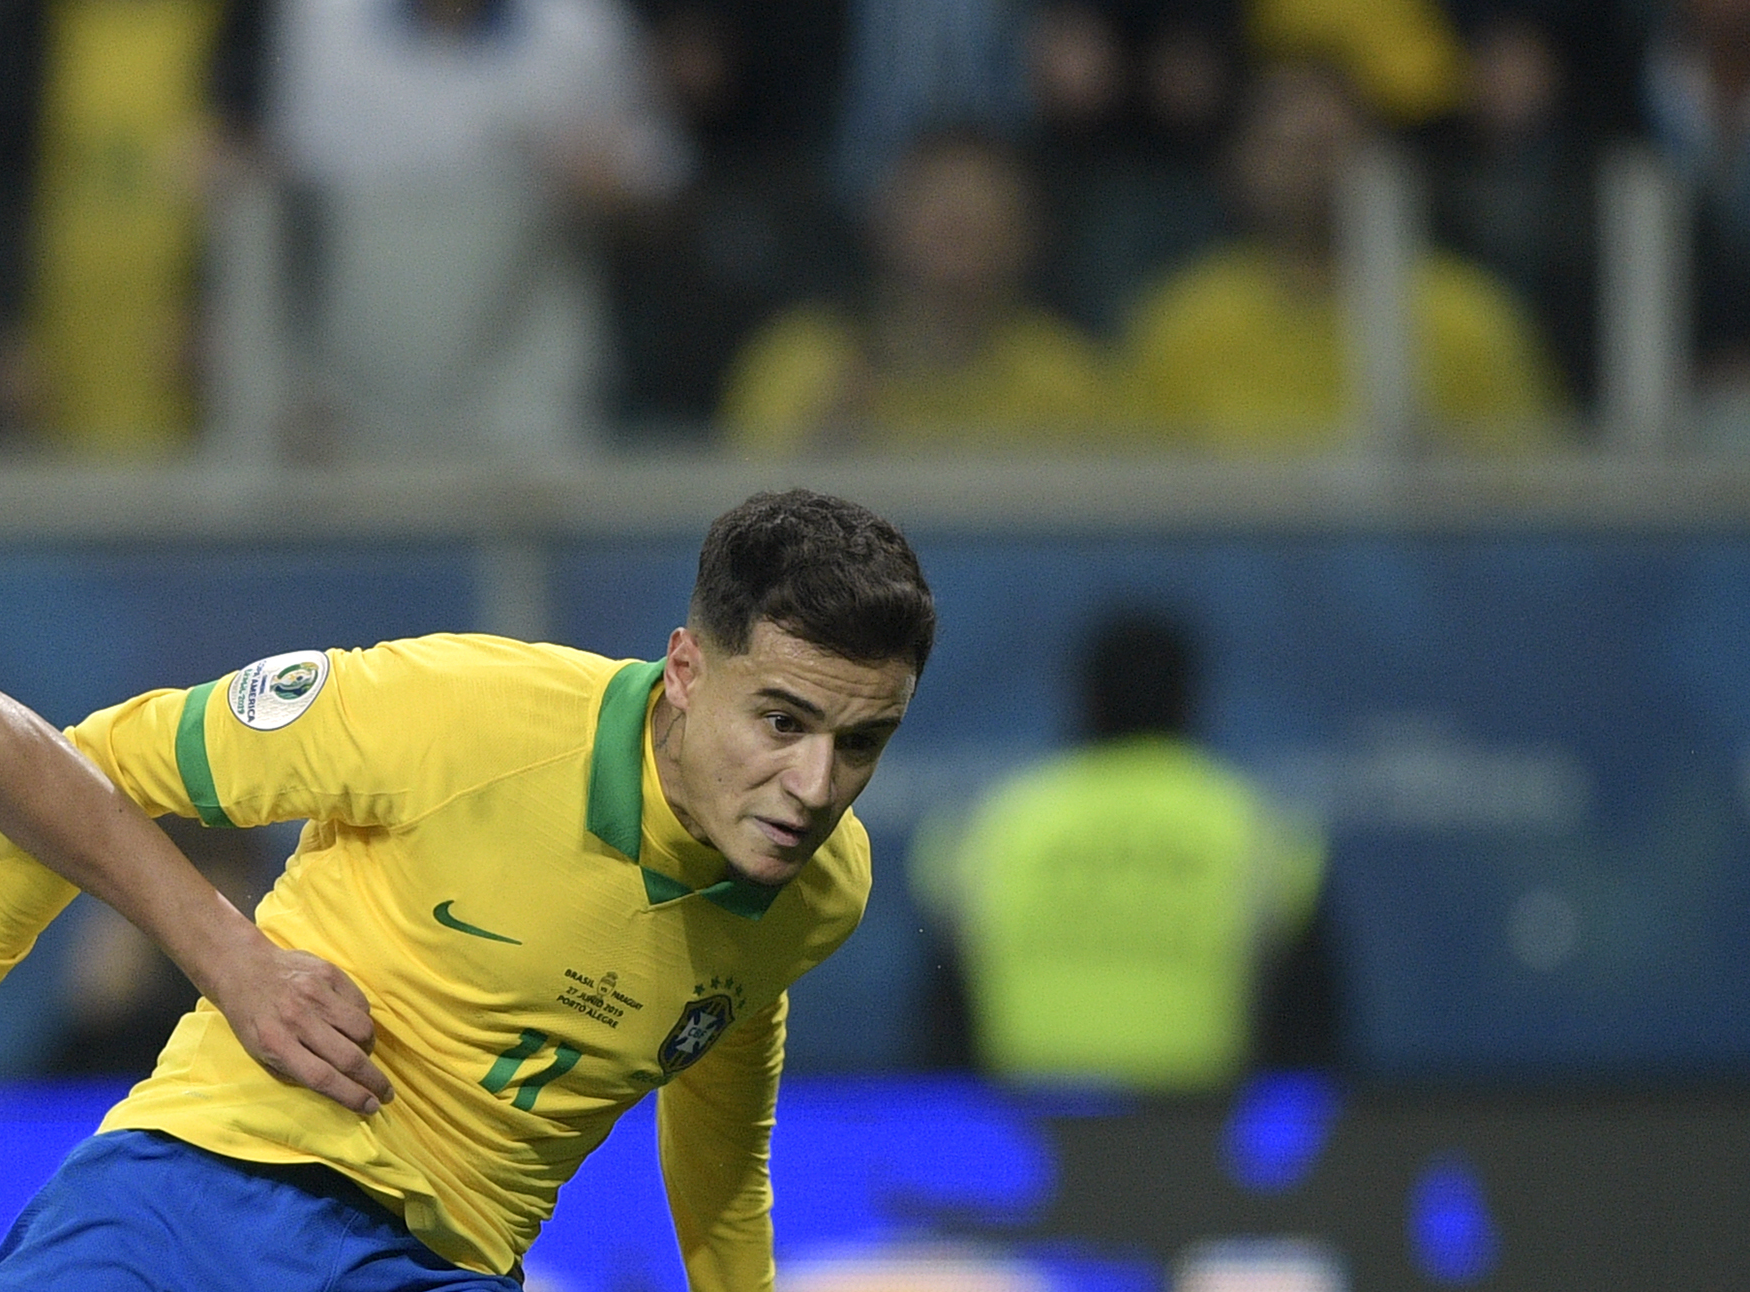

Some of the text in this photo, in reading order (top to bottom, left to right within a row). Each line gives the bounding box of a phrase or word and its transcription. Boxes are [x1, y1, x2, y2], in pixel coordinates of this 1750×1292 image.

[564, 968, 595, 988] BRASIL
[556, 995, 619, 1029] PORTO ALEGRE
[566, 986, 578, 995] 27
[603, 1003, 624, 1017] 2019
